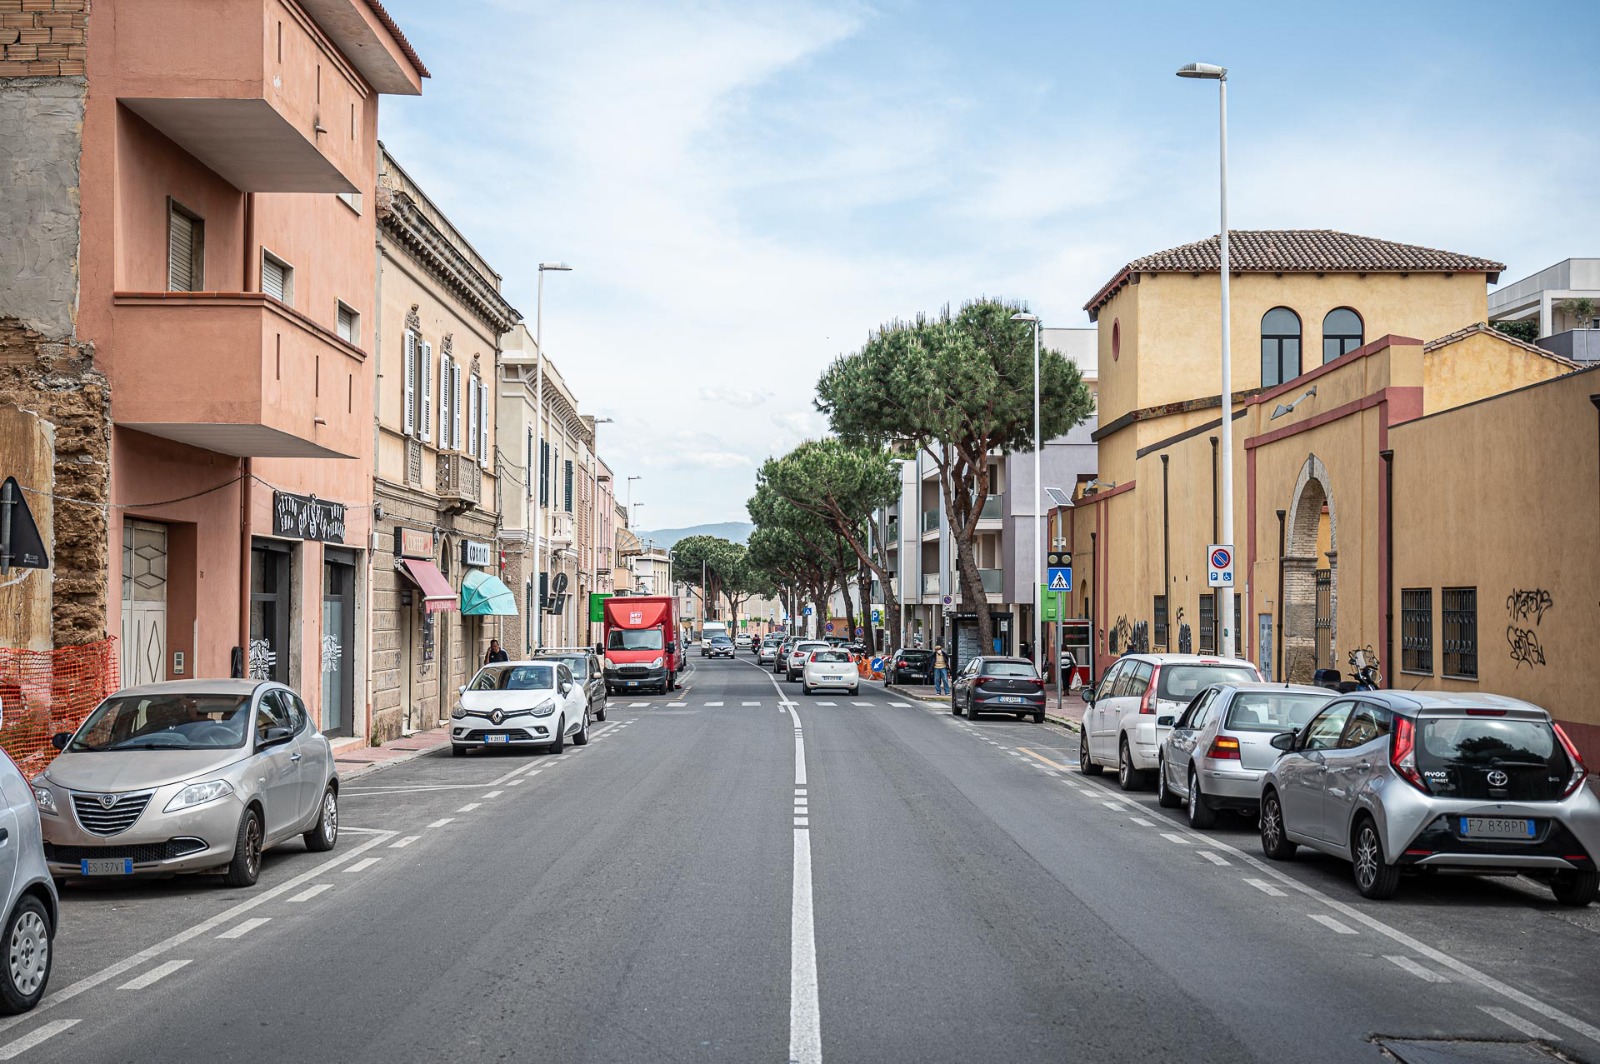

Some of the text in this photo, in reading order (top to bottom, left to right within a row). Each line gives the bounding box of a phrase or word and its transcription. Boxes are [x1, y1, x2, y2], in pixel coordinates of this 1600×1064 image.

[1469, 819, 1483, 832] FZ
[1488, 820, 1526, 833] 838PD
[88, 862, 98, 873] ES
[101, 862, 124, 872] 137VT
